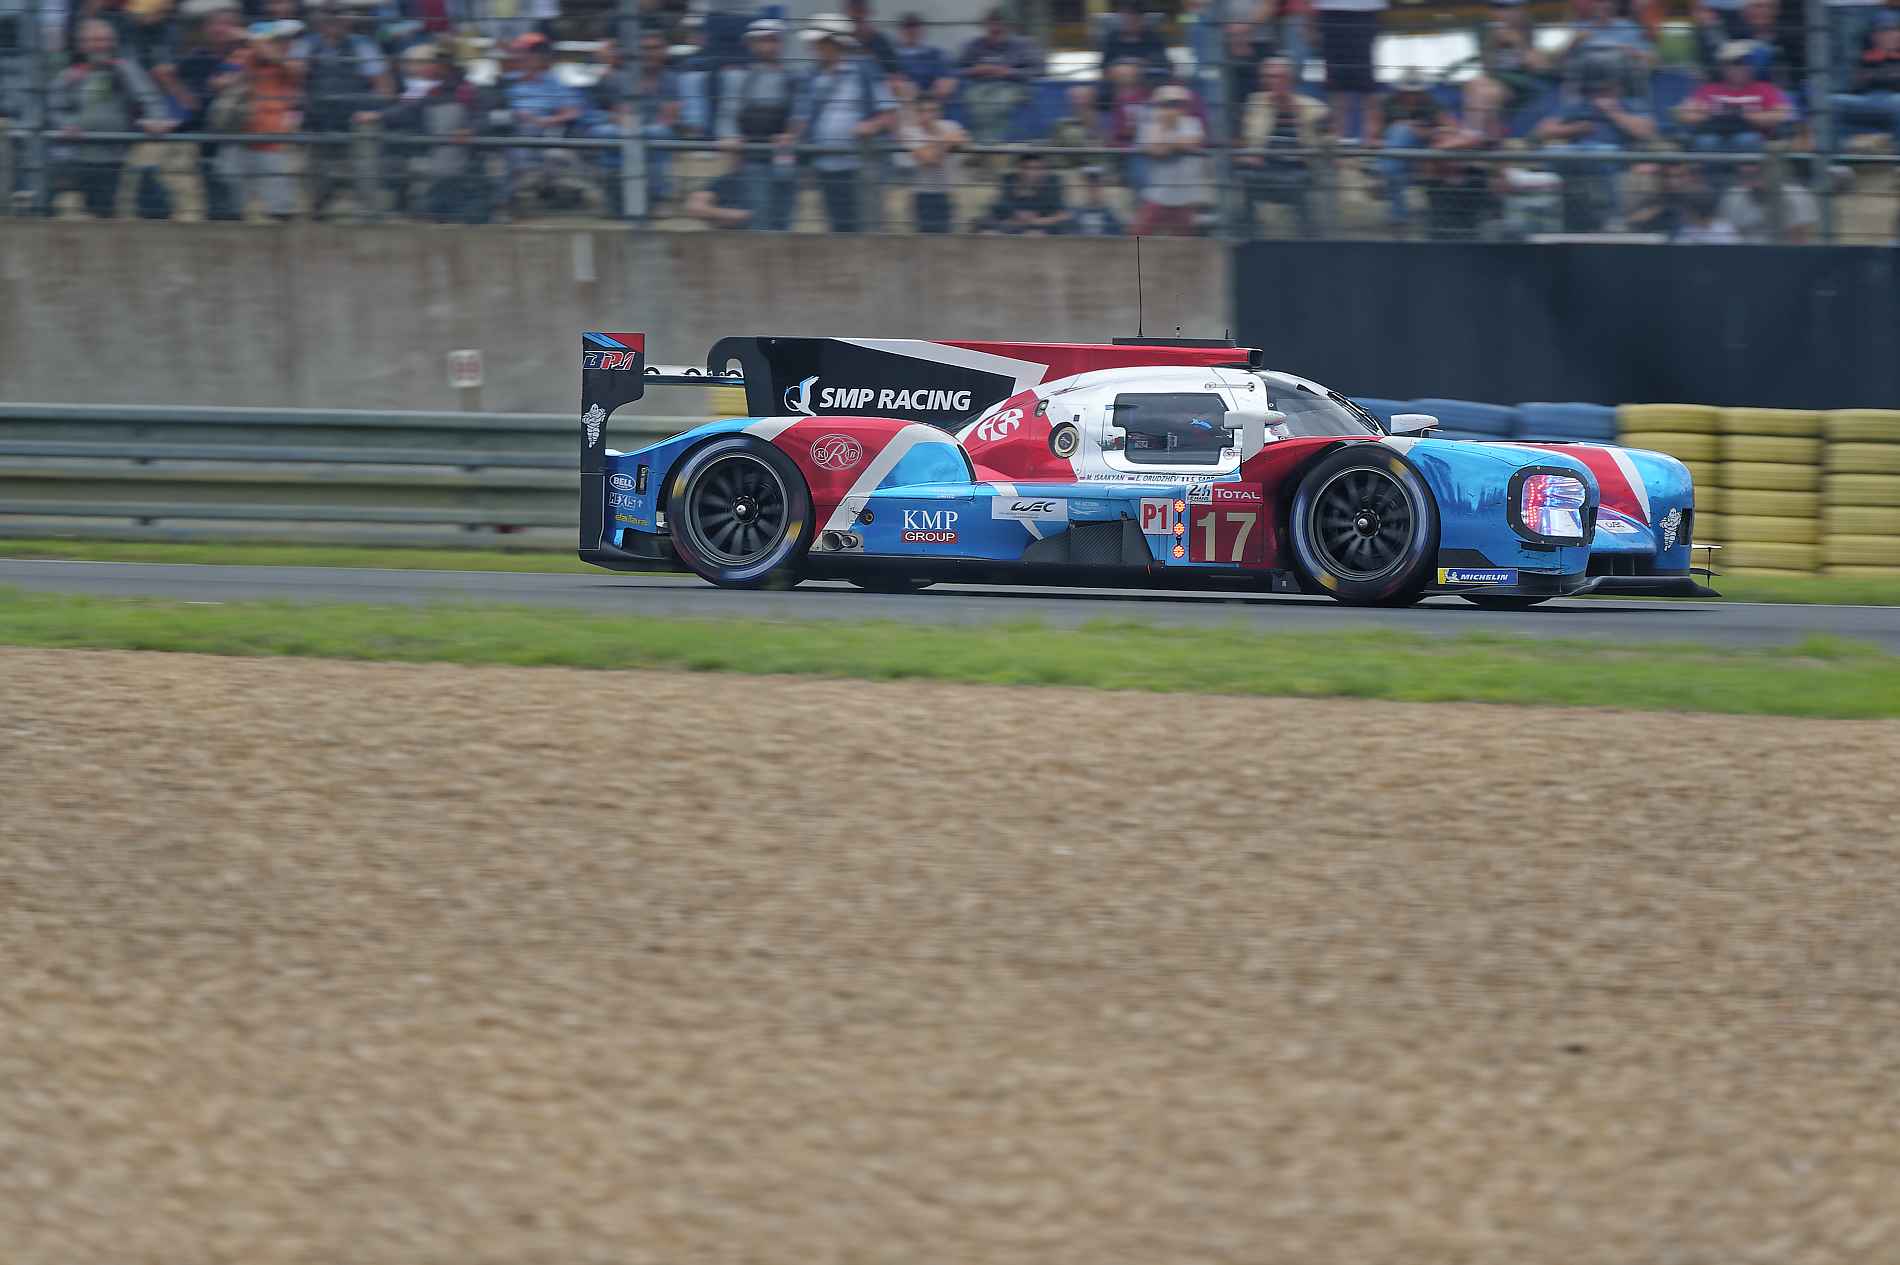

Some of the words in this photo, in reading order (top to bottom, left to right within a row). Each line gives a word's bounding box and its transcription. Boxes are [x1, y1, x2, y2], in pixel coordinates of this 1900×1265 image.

[819, 388, 873, 409] SMP
[877, 389, 971, 411] RACING
[613, 476, 633, 488] BELL
[1215, 488, 1260, 500] TOTAL
[903, 509, 959, 531] KMP
[1143, 504, 1167, 530] P1
[904, 531, 956, 542] GROUP
[1197, 511, 1256, 562] 17
[1460, 573, 1508, 582] MICHELIN
